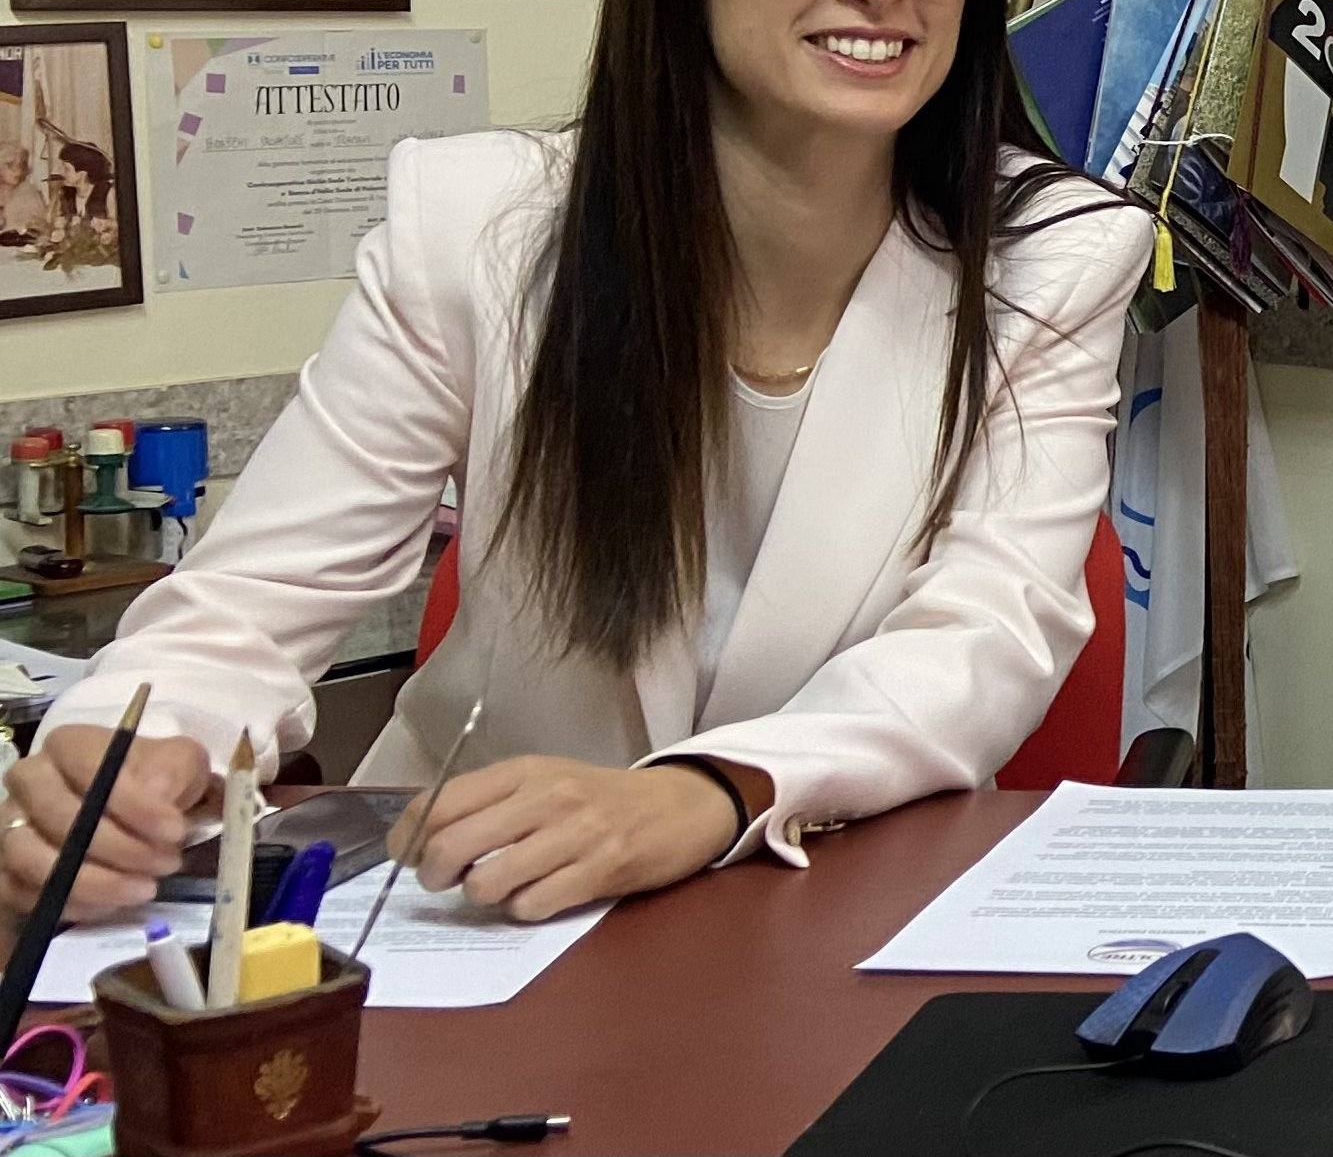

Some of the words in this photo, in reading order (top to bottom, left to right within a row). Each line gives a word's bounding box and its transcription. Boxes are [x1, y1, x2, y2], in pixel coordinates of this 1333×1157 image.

[377, 59, 400, 70] PER
[403, 58, 434, 70] TUTTI
[255, 81, 400, 115] ATTESTATO
